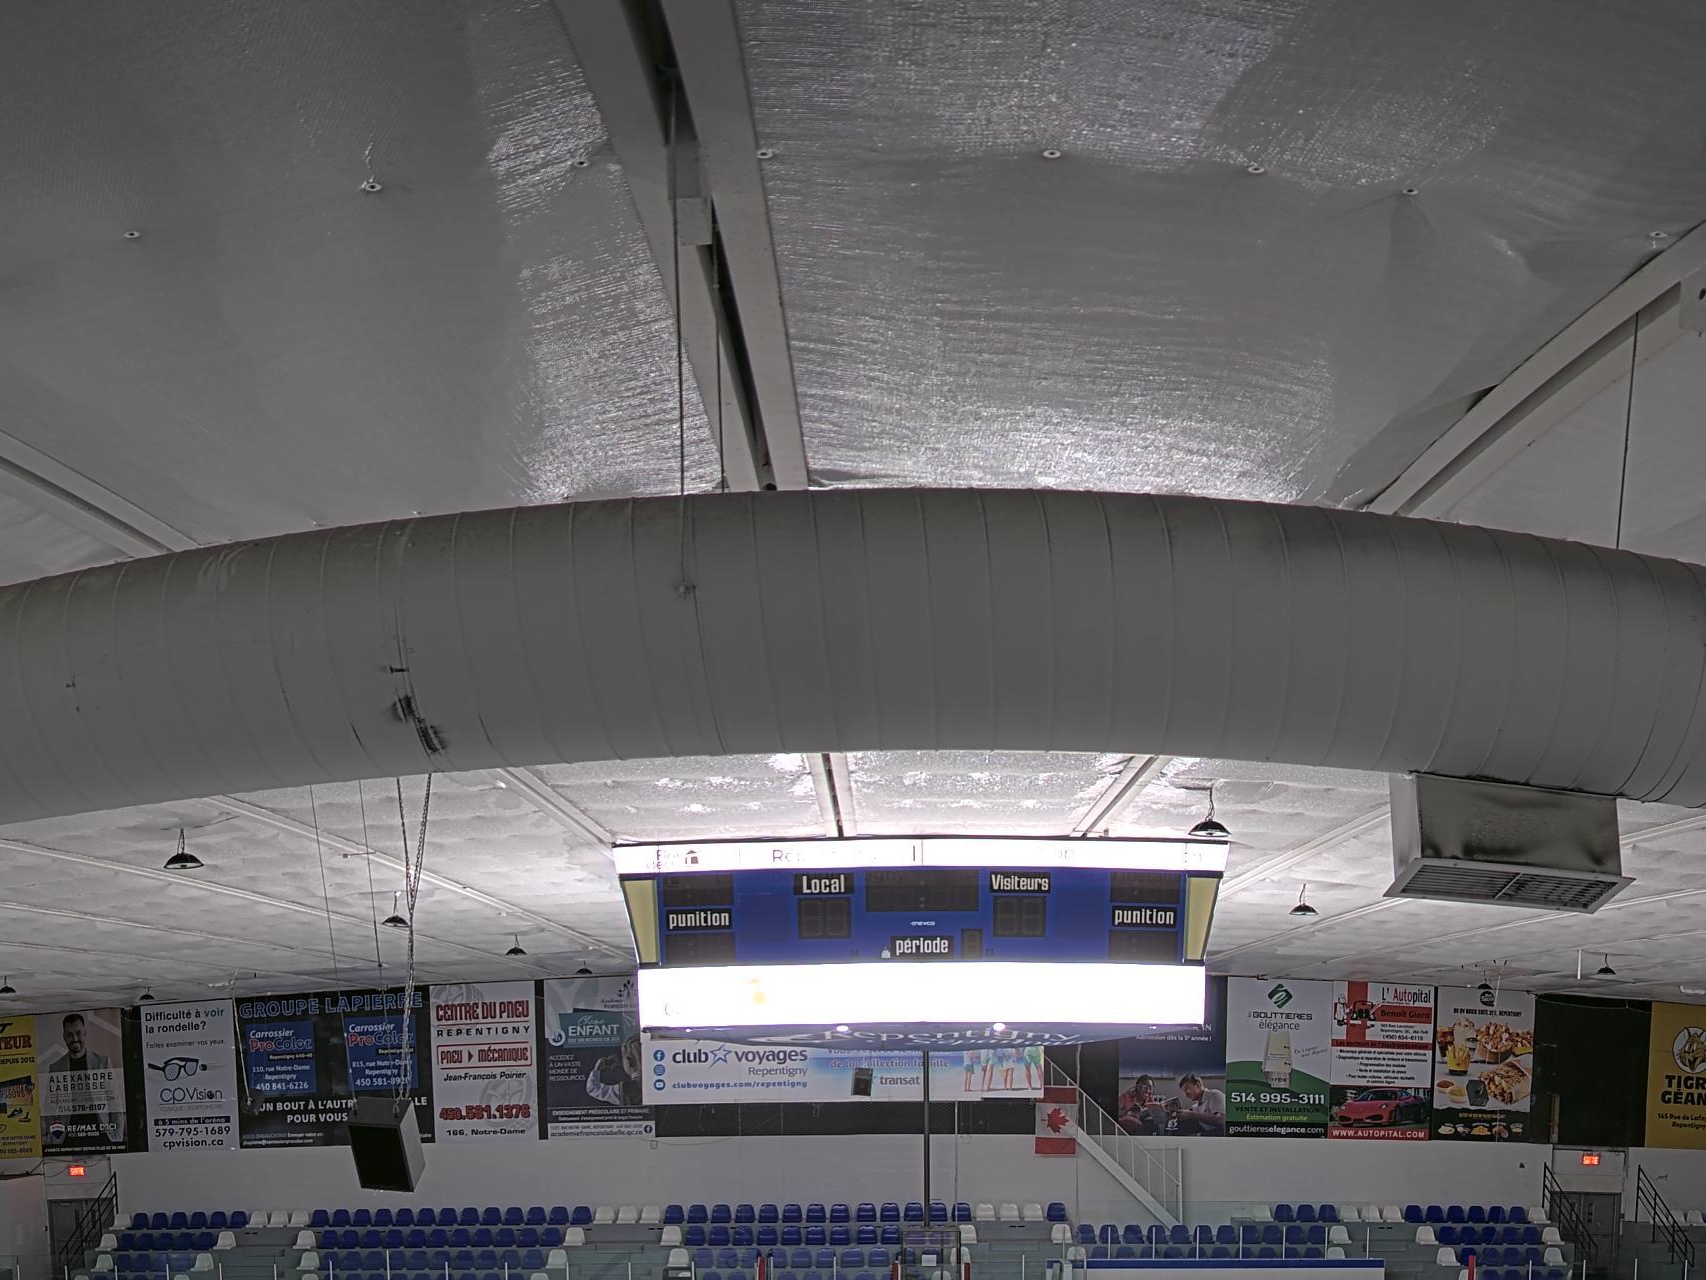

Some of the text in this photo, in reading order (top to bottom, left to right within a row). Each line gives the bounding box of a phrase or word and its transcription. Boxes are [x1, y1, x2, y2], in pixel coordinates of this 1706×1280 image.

[802, 874, 845, 893] Local
[991, 873, 1049, 892] Visiteurs
[668, 910, 730, 930] punition
[1114, 908, 1174, 926] punition
[895, 937, 949, 957] période
[1382, 987, 1431, 1005] L' Autopital
[239, 991, 423, 1019] GROUPE LAPIERRE
[436, 1000, 529, 1021] CENTRE DU PNEU
[145, 1007, 225, 1022] Difficulté à voir
[145, 1021, 206, 1034] la rondelle?
[348, 1022, 395, 1033] Carrossier
[437, 1025, 530, 1037] REPENTIGNY
[568, 1024, 620, 1036] ENFANT
[1259, 1020, 1300, 1032] élégance
[250, 1027, 294, 1039] Carrossier
[249, 1037, 313, 1052] ProColor
[440, 1046, 529, 1064] PNEU MÉCANIQUE
[672, 1048, 808, 1066] club voyages
[49, 1072, 113, 1083] ALEXANDRE
[499, 1071, 527, 1080] Poirier
[748, 1066, 808, 1078] Repentigny
[272, 1081, 309, 1090] 841-6226
[355, 1077, 370, 1086] 450
[672, 1080, 808, 1089] clubvoyages.com/repentigny
[879, 1075, 920, 1085] transat
[49, 1082, 106, 1092] LABROSSE
[160, 1087, 223, 1105] cpVision
[1230, 1092, 1325, 1105] 514 995-3111
[276, 1099, 355, 1111] BOUT À L'AUTR
[287, 1112, 348, 1123] POUR VOUS
[1282, 1114, 1308, 1122] gratuite
[67, 1124, 97, 1132] RE/MAX
[155, 1126, 231, 1137] 579-795-1689
[1229, 1124, 1324, 1135] gouttiereselegance.com
[1672, 1122, 1706, 1130] Repentigny
[446, 1128, 526, 1137] 166, Notre-Dame
[1333, 1129, 1425, 1138] WWW.AUTOPITAL.COM
[163, 1138, 224, 1150] cpvision.ca
